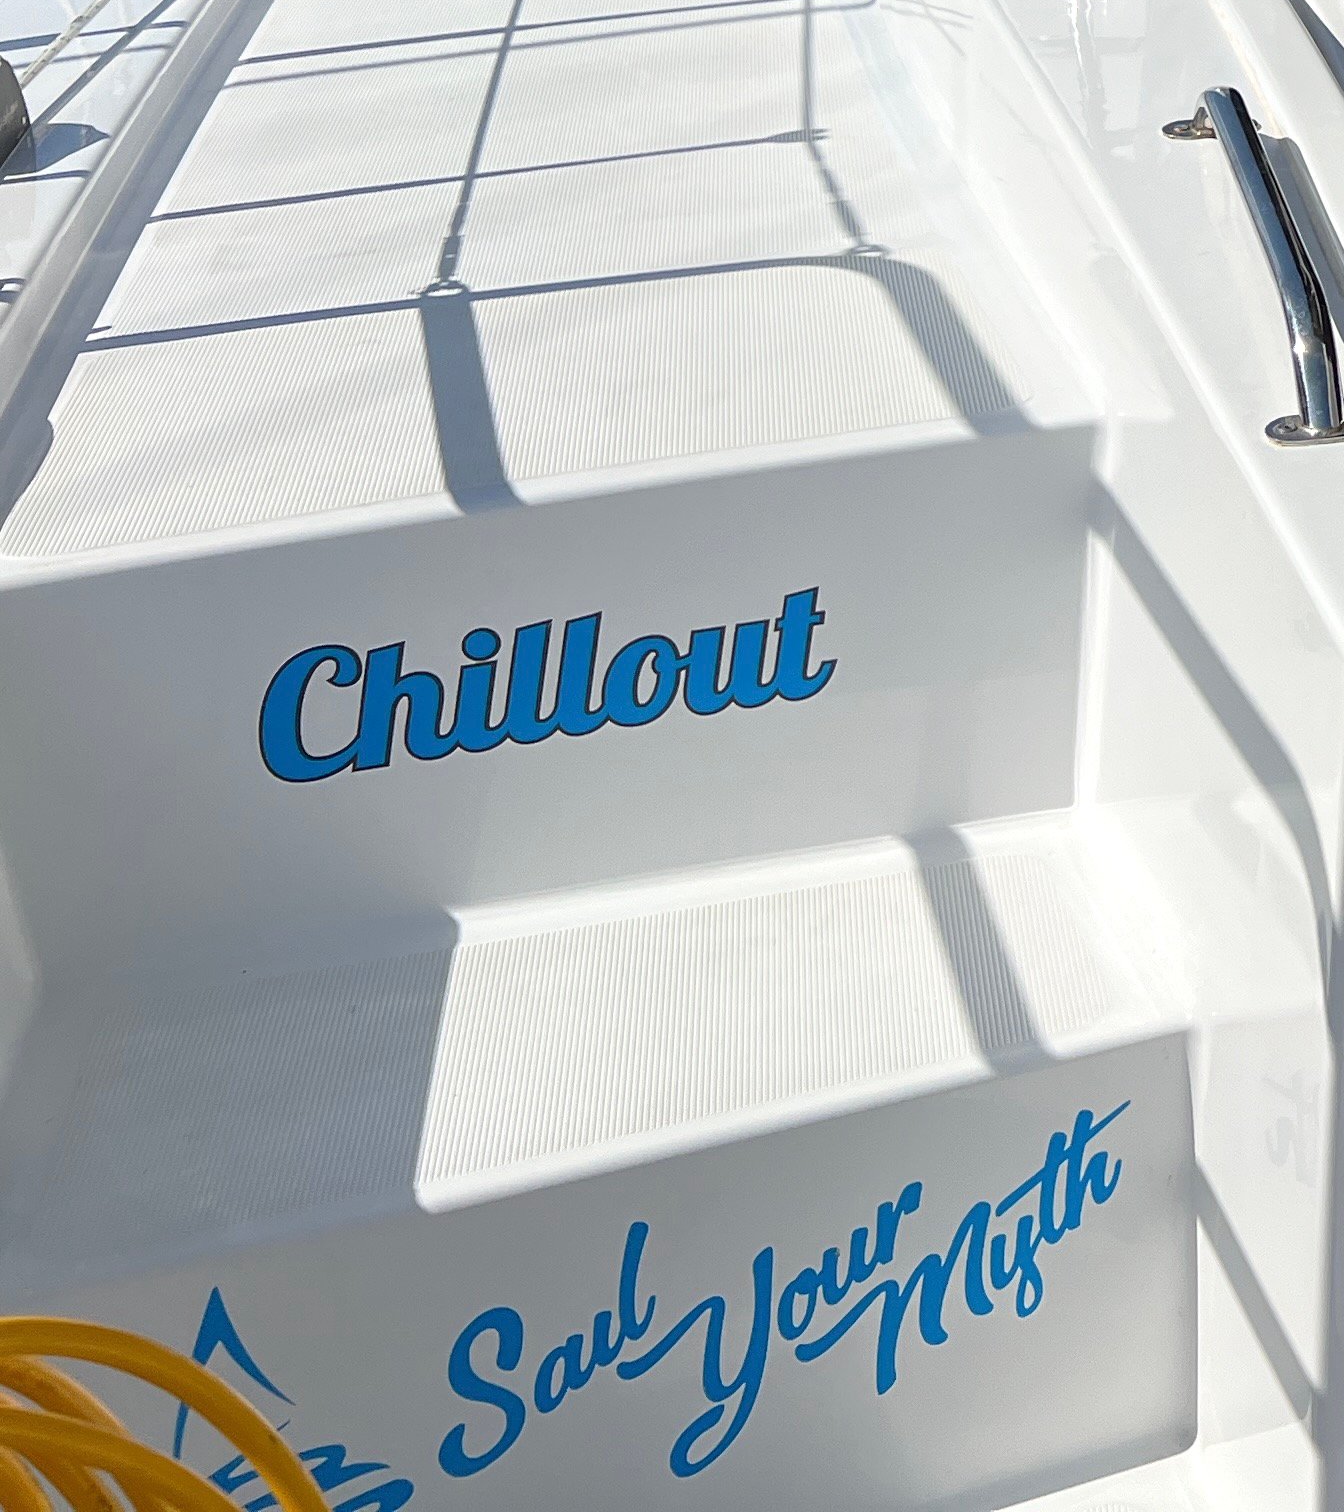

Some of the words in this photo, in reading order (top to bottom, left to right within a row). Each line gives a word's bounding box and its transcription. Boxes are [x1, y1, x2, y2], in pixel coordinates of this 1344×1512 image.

[259, 587, 836, 783] Chillout
[439, 1221, 656, 1478] Sail
[617, 1182, 923, 1478] Your
[795, 1101, 1130, 1394] Myth
